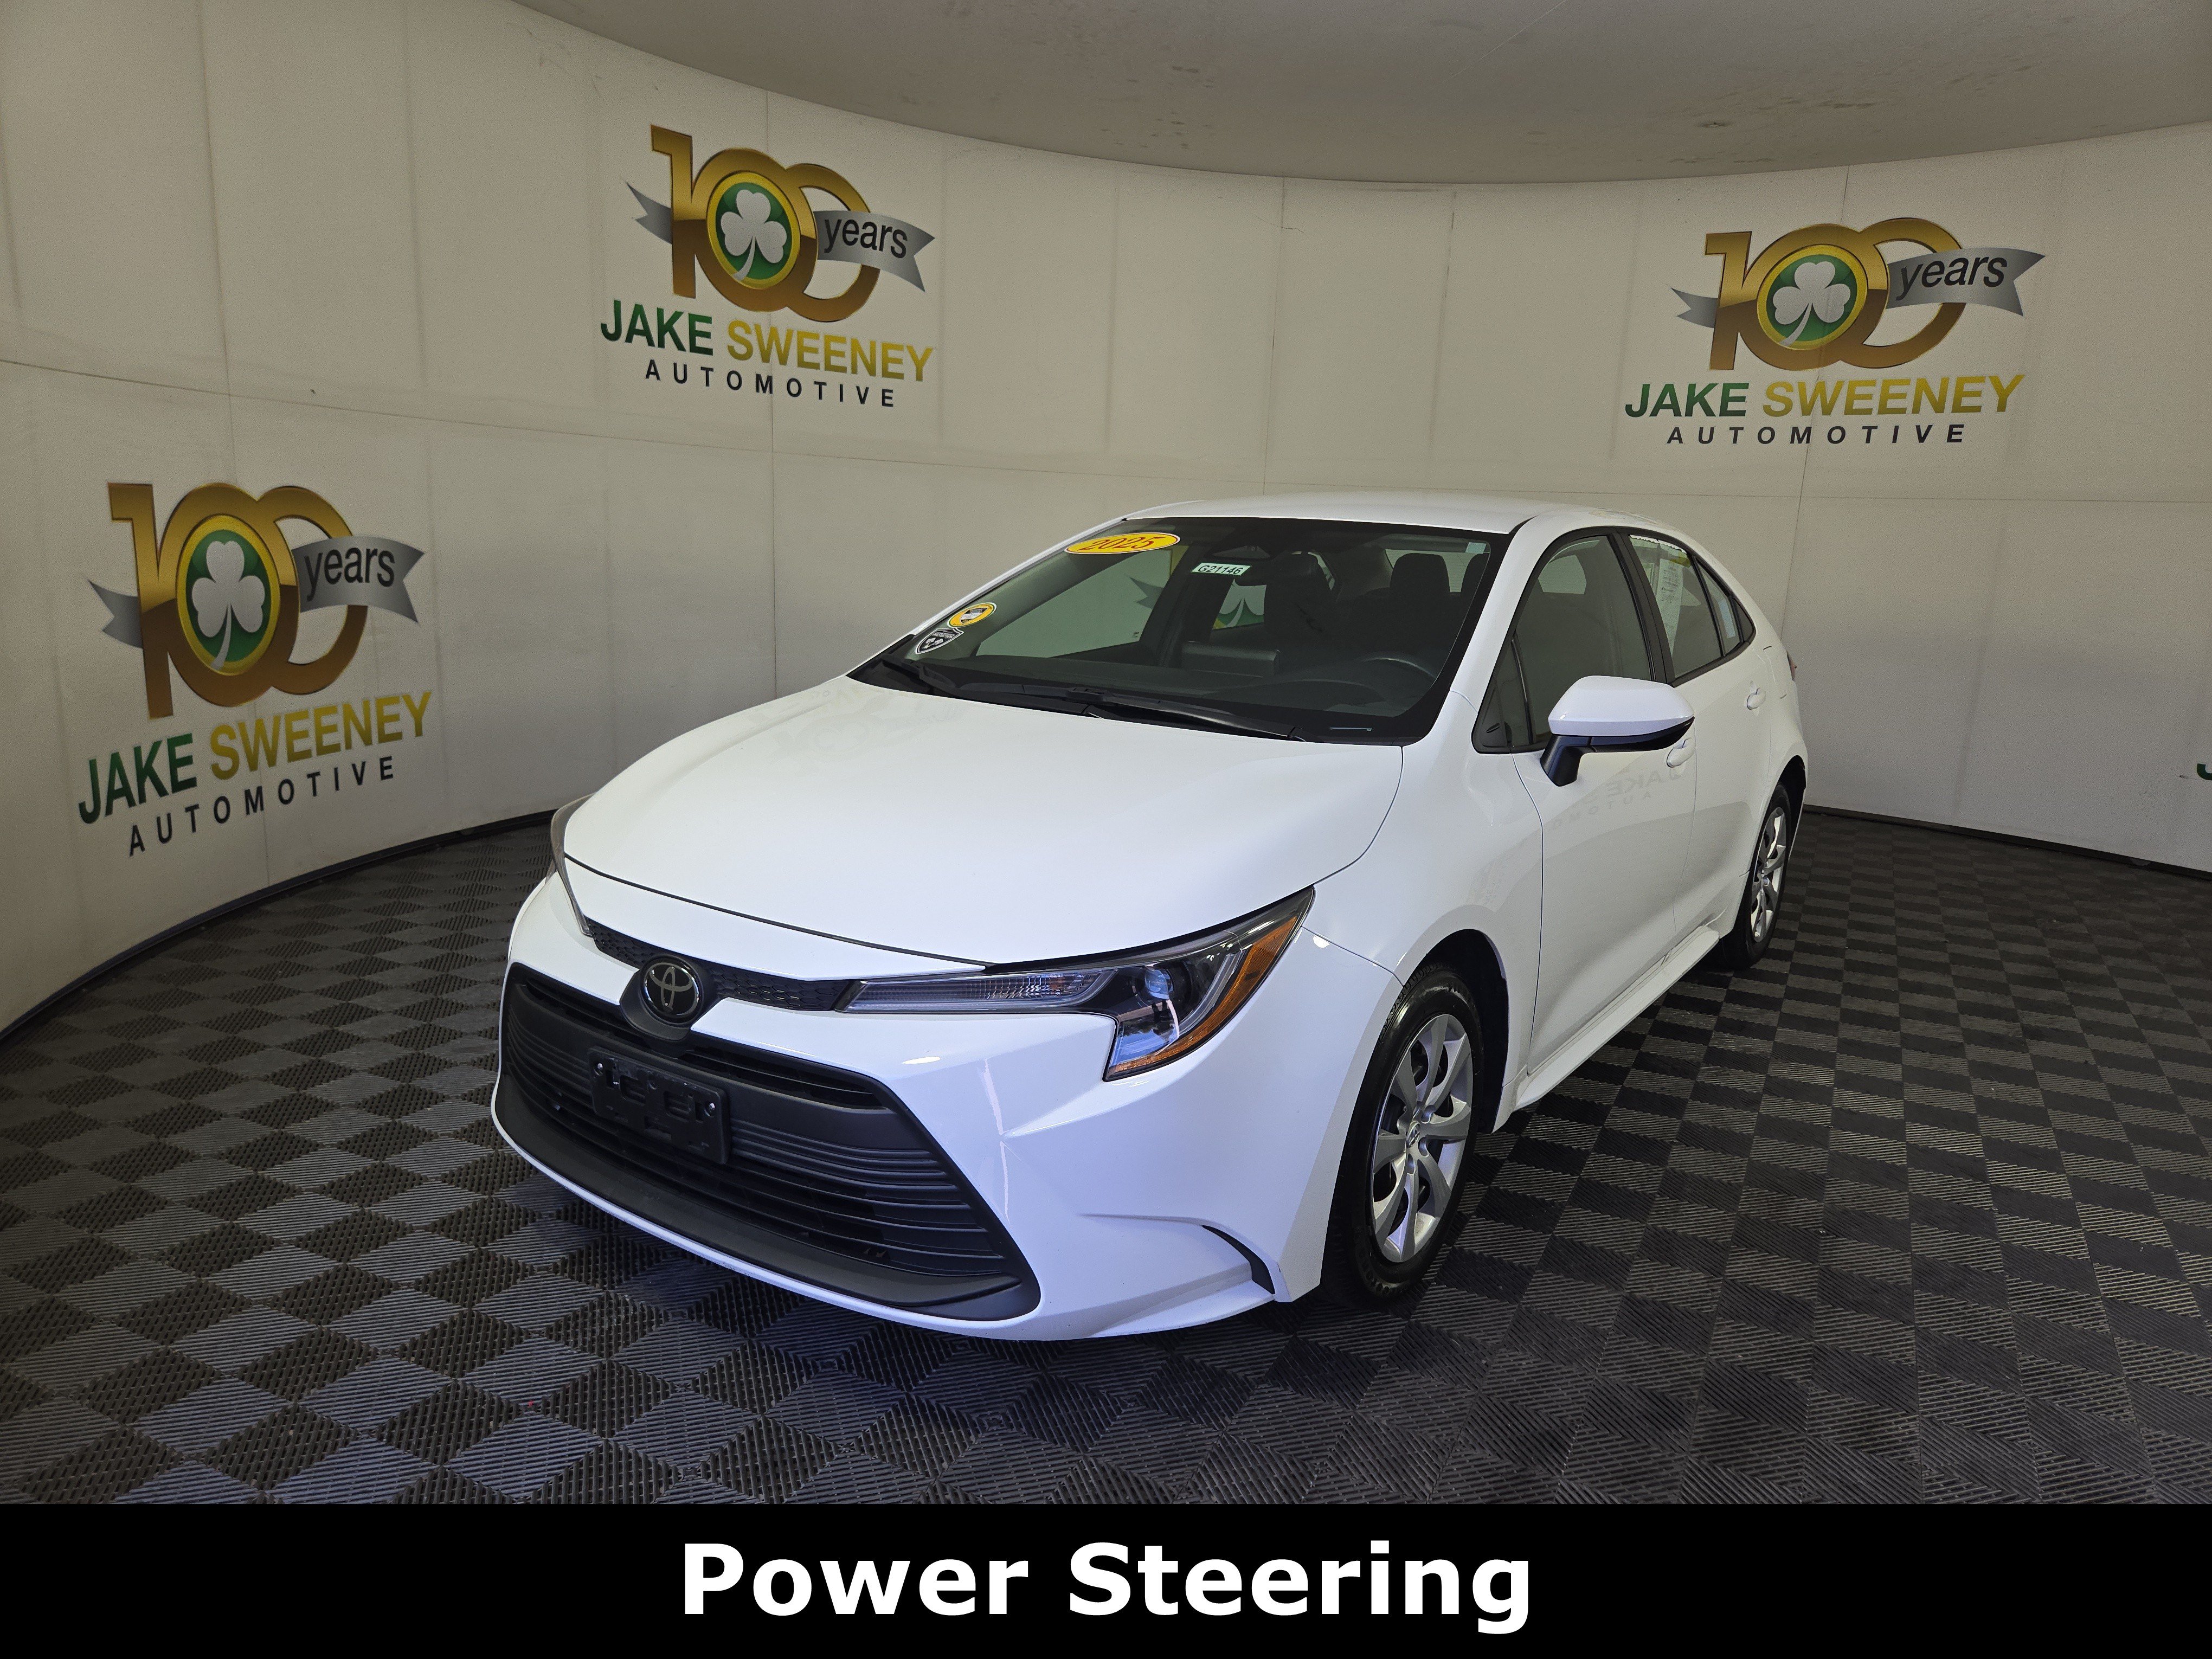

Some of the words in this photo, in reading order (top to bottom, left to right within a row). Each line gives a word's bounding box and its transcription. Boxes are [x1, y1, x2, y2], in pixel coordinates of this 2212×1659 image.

[650, 124, 880, 322] 100
[824, 217, 908, 259] years
[1705, 217, 1966, 371] 100
[1895, 255, 2008, 300] years
[600, 299, 713, 356] JAKE
[727, 319, 934, 382] SWEENEY
[645, 359, 895, 408] AUTOMOTIVE
[1625, 382, 1749, 417] JAKE
[1762, 374, 2025, 417] SWEENEY
[1666, 424, 1965, 445] AUTOMOTIVE
[1077, 536, 1166, 552] 2025
[1198, 564, 1244, 575] G21146
[304, 546, 395, 601] years
[107, 482, 368, 720] 100
[78, 732, 198, 824] JAKE
[209, 691, 432, 780] SWEENEY
[128, 756, 394, 857] AUTOMOTIVE
